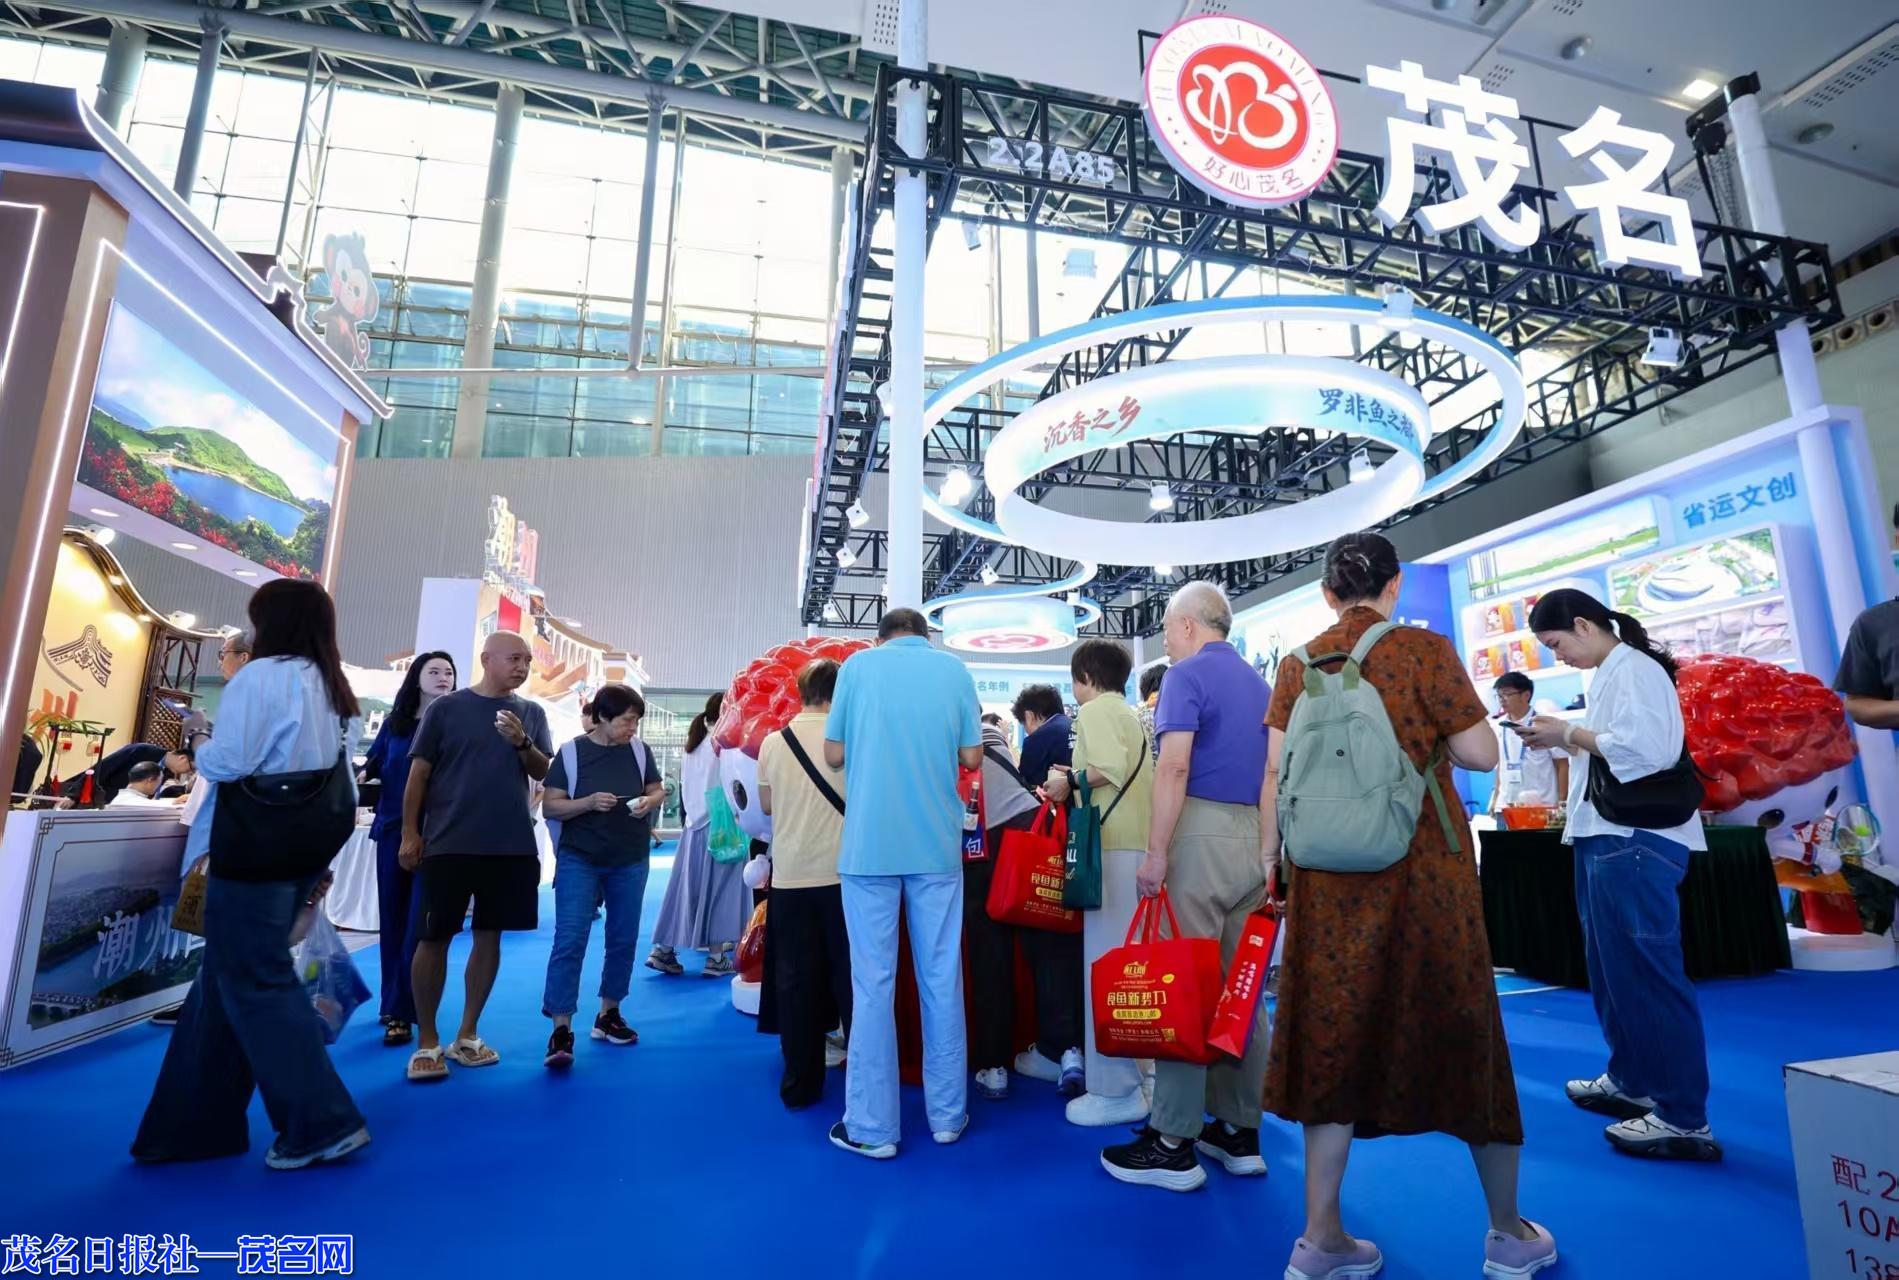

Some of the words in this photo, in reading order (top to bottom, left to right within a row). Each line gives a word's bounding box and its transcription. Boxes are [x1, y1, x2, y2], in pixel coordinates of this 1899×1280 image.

[989, 136, 1114, 182] 2.2A85
[1203, 155, 1304, 194] 好心茂名
[1366, 59, 1703, 282] 茂名
[1043, 395, 1142, 454] 沉香之乡
[1318, 388, 1415, 444] 罗非鱼之都
[1683, 472, 1797, 528] 省运文创
[974, 680, 1009, 692] 名年例
